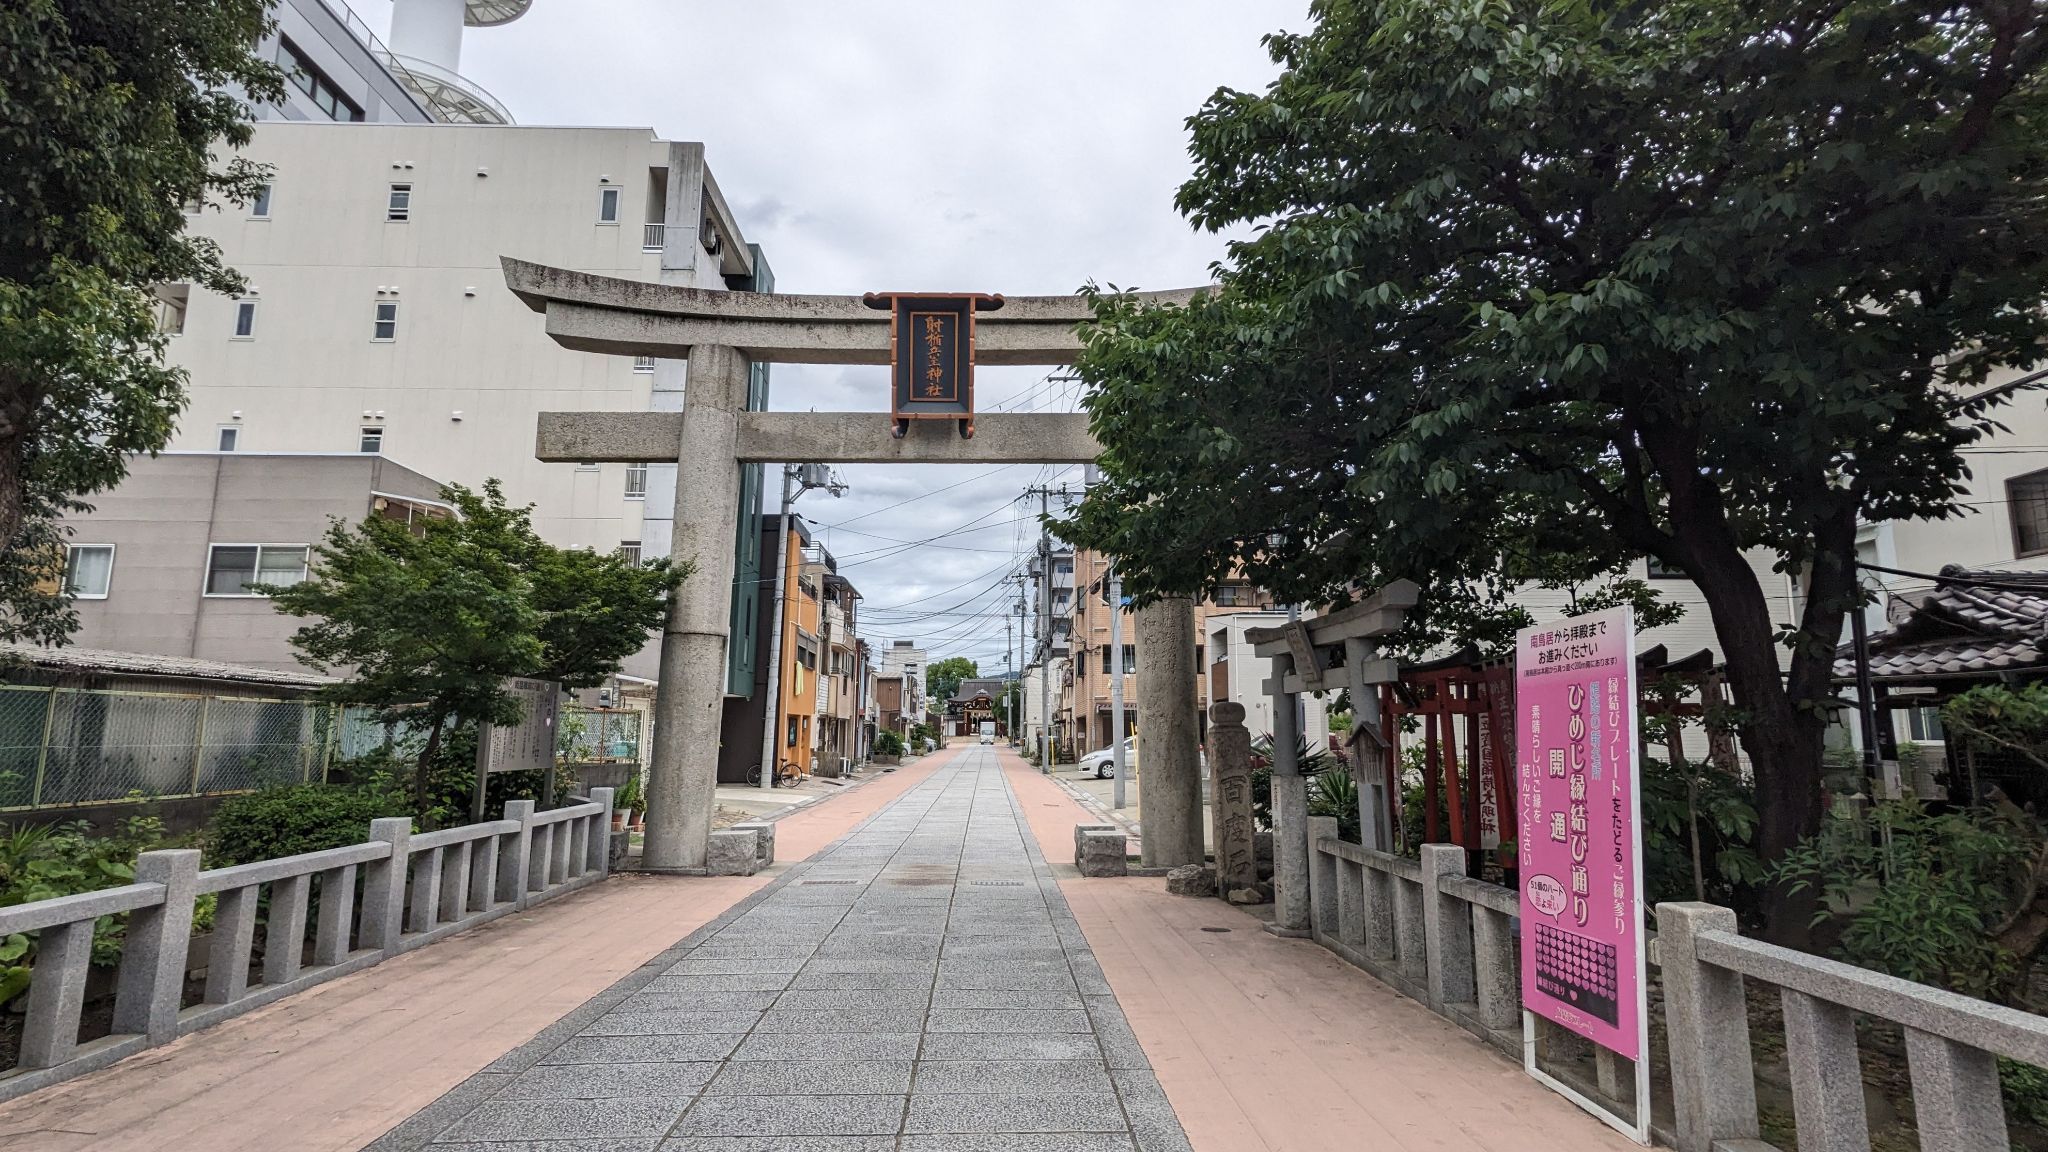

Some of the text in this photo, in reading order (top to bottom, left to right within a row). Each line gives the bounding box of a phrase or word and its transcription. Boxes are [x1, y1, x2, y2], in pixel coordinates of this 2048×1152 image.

[924, 315, 944, 397] 射楯兵主神社
[1530, 620, 1607, 649] 南鳥居から拝殿まで
[1538, 642, 1598, 665] お進みください
[1521, 763, 1532, 866] 結んでください
[1531, 705, 1542, 823] 素晴らしいご縁を
[1568, 683, 1590, 927] ひめじ縁結び通り
[1607, 677, 1625, 935] 縁結びプレートをたどるご縁参り
[1220, 774, 1251, 879] 百度石
[1530, 880, 1564, 896] 51個のハート
